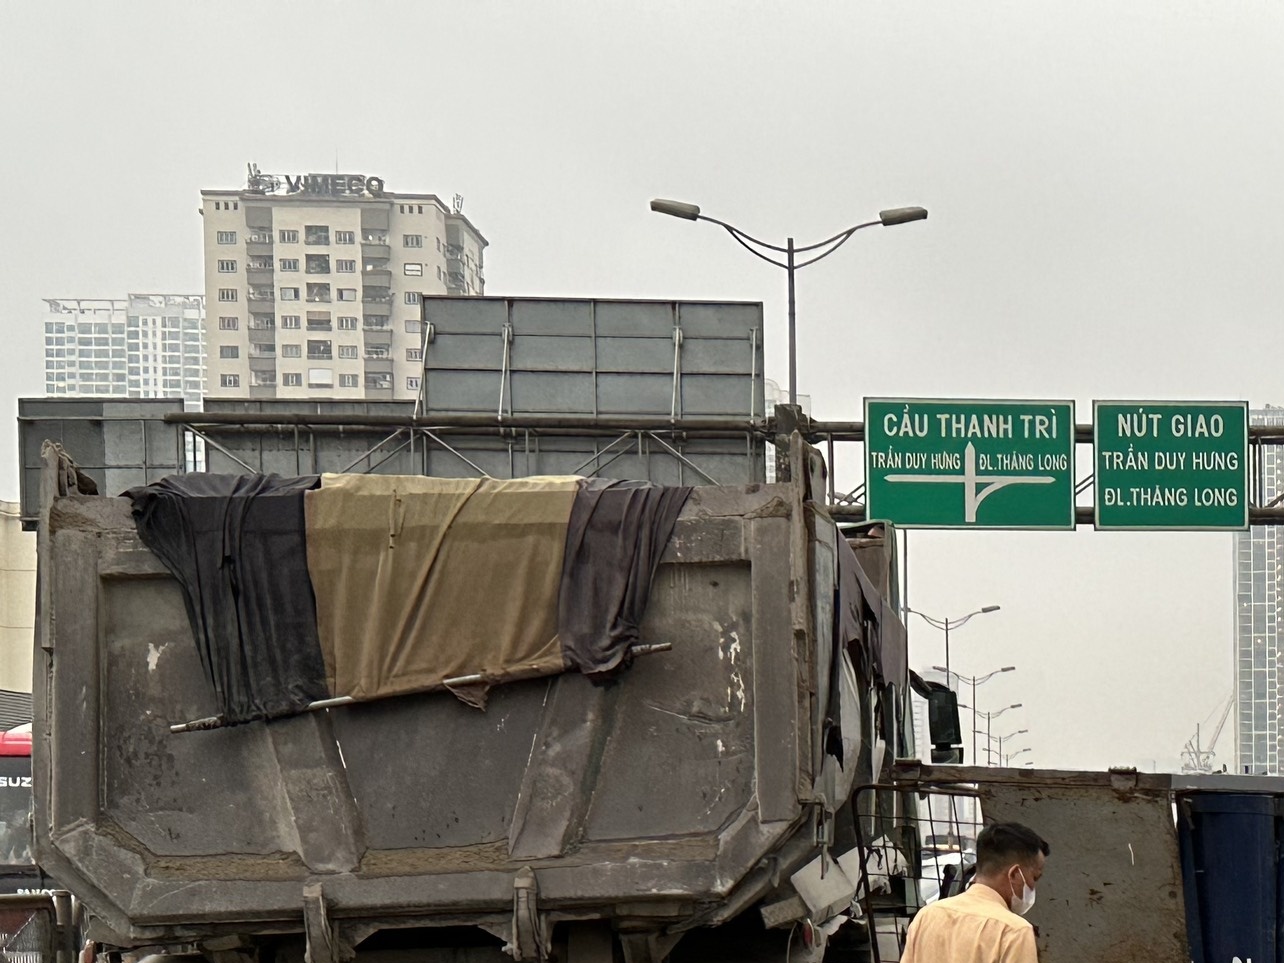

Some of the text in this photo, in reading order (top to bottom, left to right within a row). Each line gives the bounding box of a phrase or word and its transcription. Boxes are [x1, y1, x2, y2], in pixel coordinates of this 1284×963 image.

[284, 174, 384, 196] VIMECO
[883, 404, 1058, 439] CẦU THANH TRÌ
[1117, 407, 1224, 438] NÚT GIAO
[871, 445, 961, 470] TRẦN DUY HƯNG
[1038, 453, 1068, 471] LONG
[1102, 443, 1239, 471] TRẦN DUY HƯNG
[1194, 487, 1238, 507] LONG
